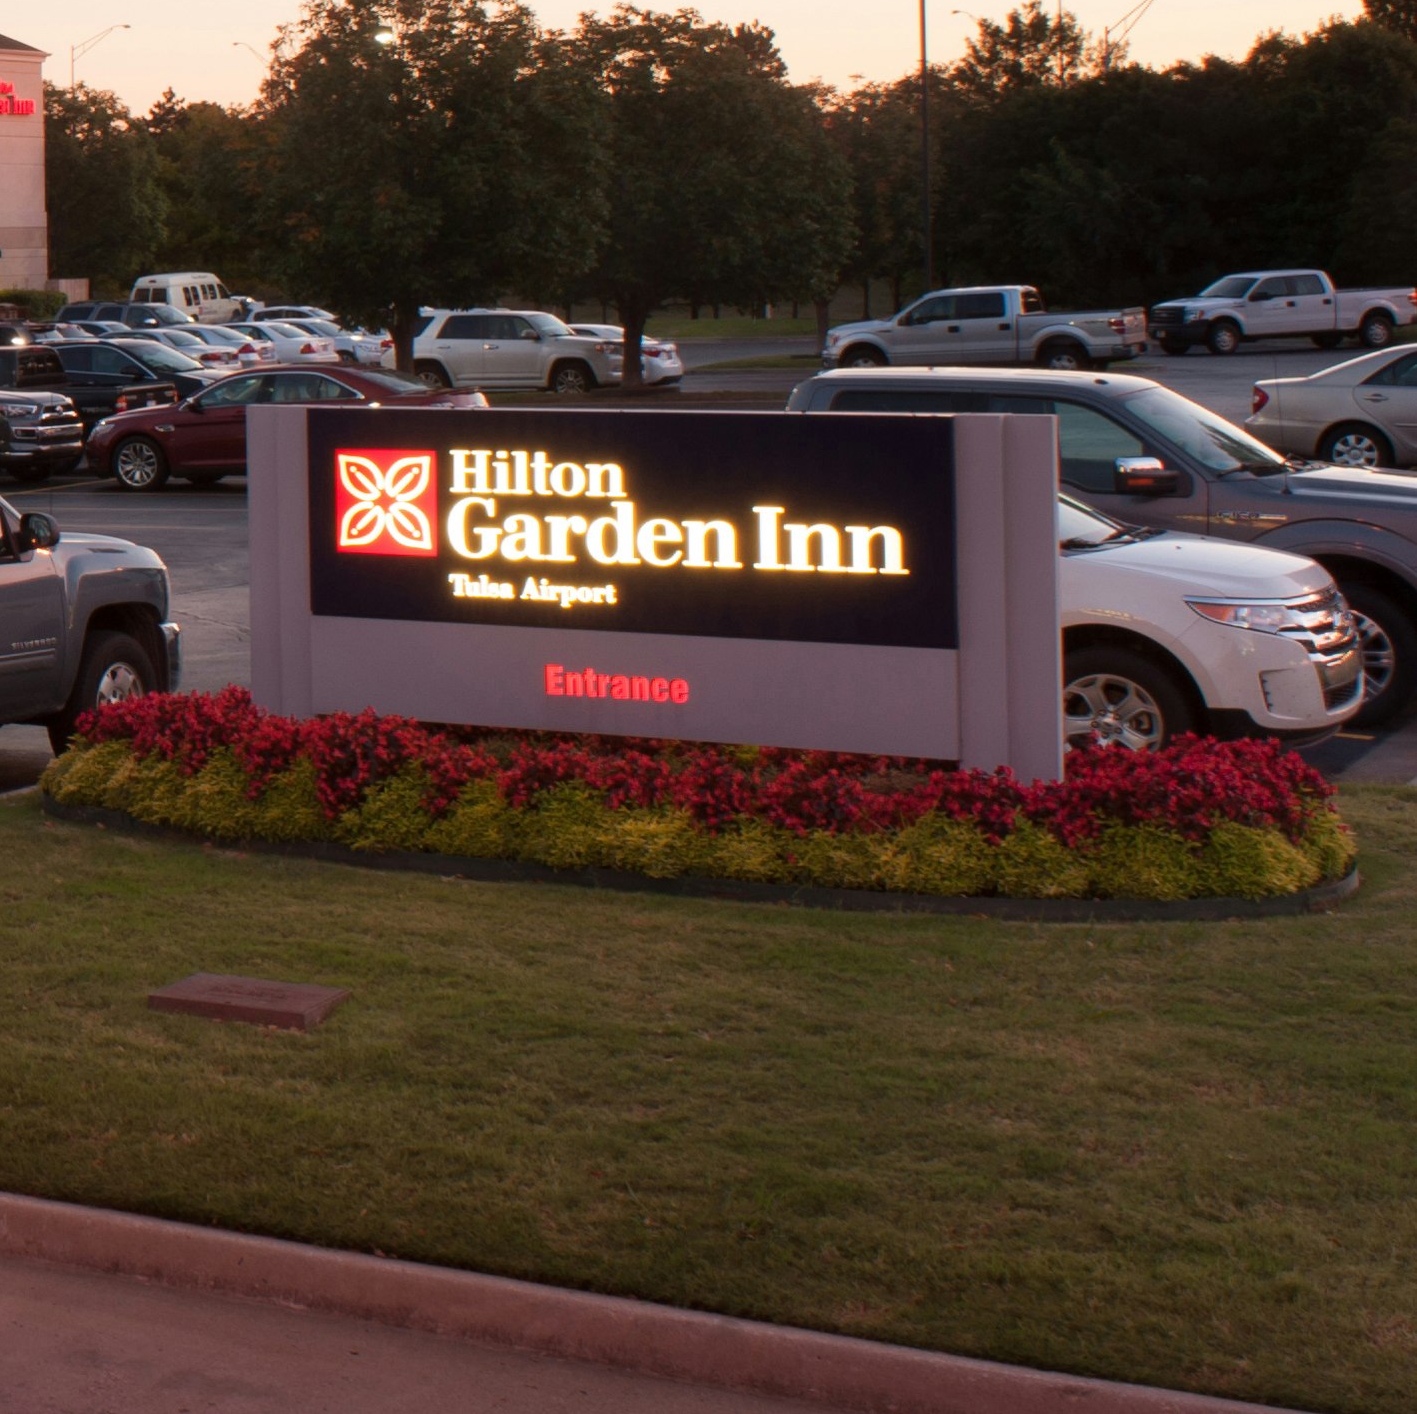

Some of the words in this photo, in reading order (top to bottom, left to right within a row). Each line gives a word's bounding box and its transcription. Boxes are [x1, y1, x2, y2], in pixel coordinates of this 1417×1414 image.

[9, 94, 35, 115] Inn
[448, 448, 627, 498] Hilton
[445, 495, 744, 569] Garden
[751, 505, 910, 575] Inn
[447, 572, 515, 600] Tulsa
[519, 576, 617, 608] Airport
[543, 662, 690, 704] Entrance
